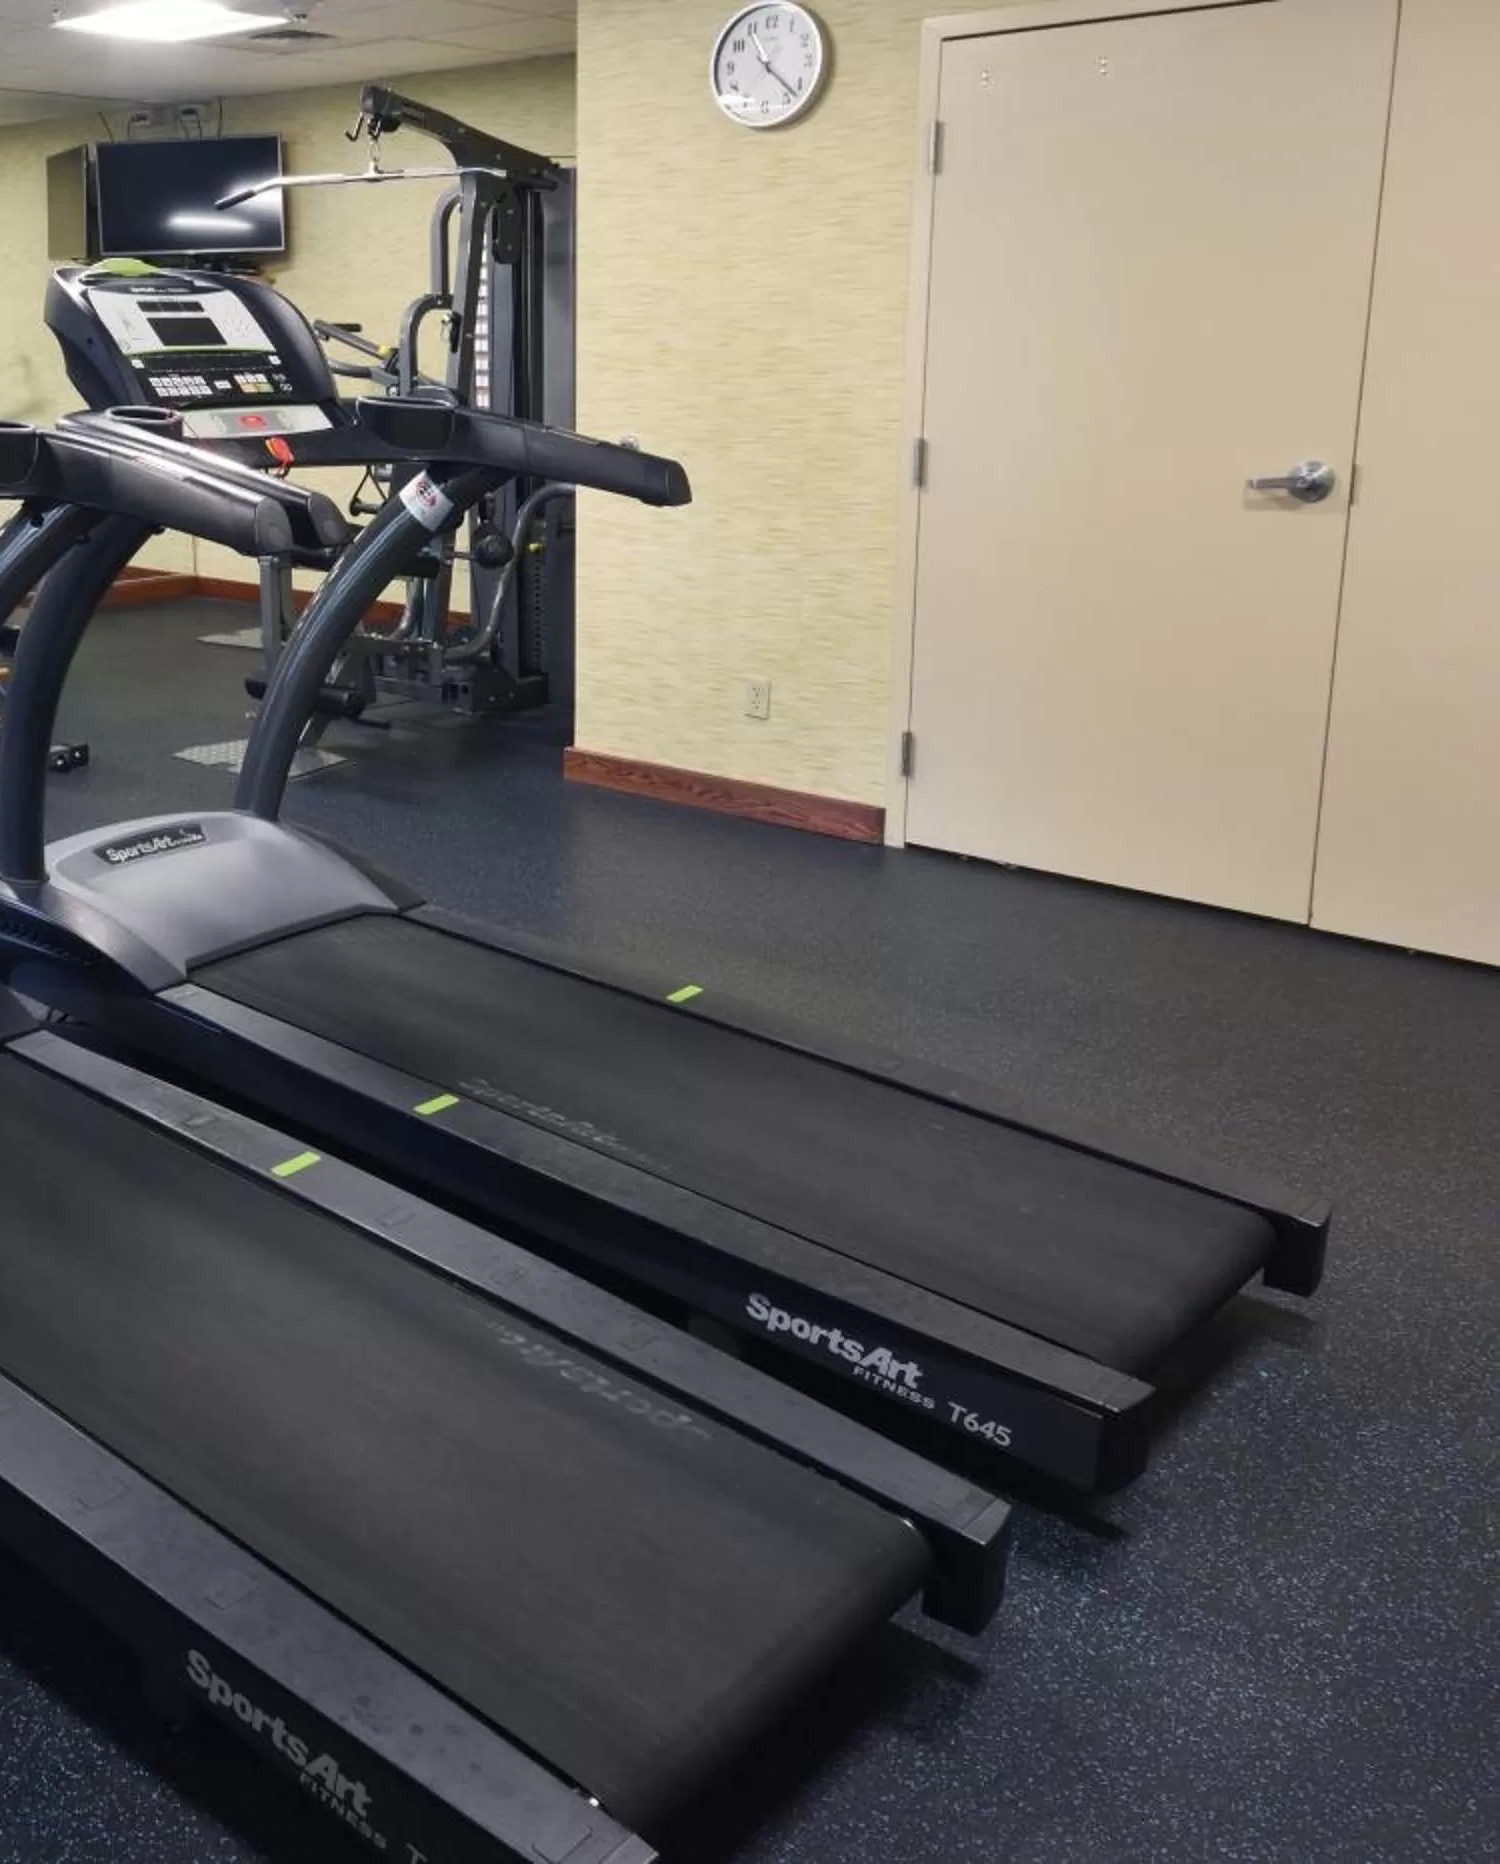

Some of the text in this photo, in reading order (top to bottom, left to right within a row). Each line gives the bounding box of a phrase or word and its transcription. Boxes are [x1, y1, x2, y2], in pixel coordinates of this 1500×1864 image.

[105, 836, 176, 861] SportsArt
[746, 1293, 923, 1389] SportsArt
[852, 1366, 935, 1409] FITNESS
[948, 1401, 1012, 1447] T645
[187, 1649, 372, 1818] SportsArt
